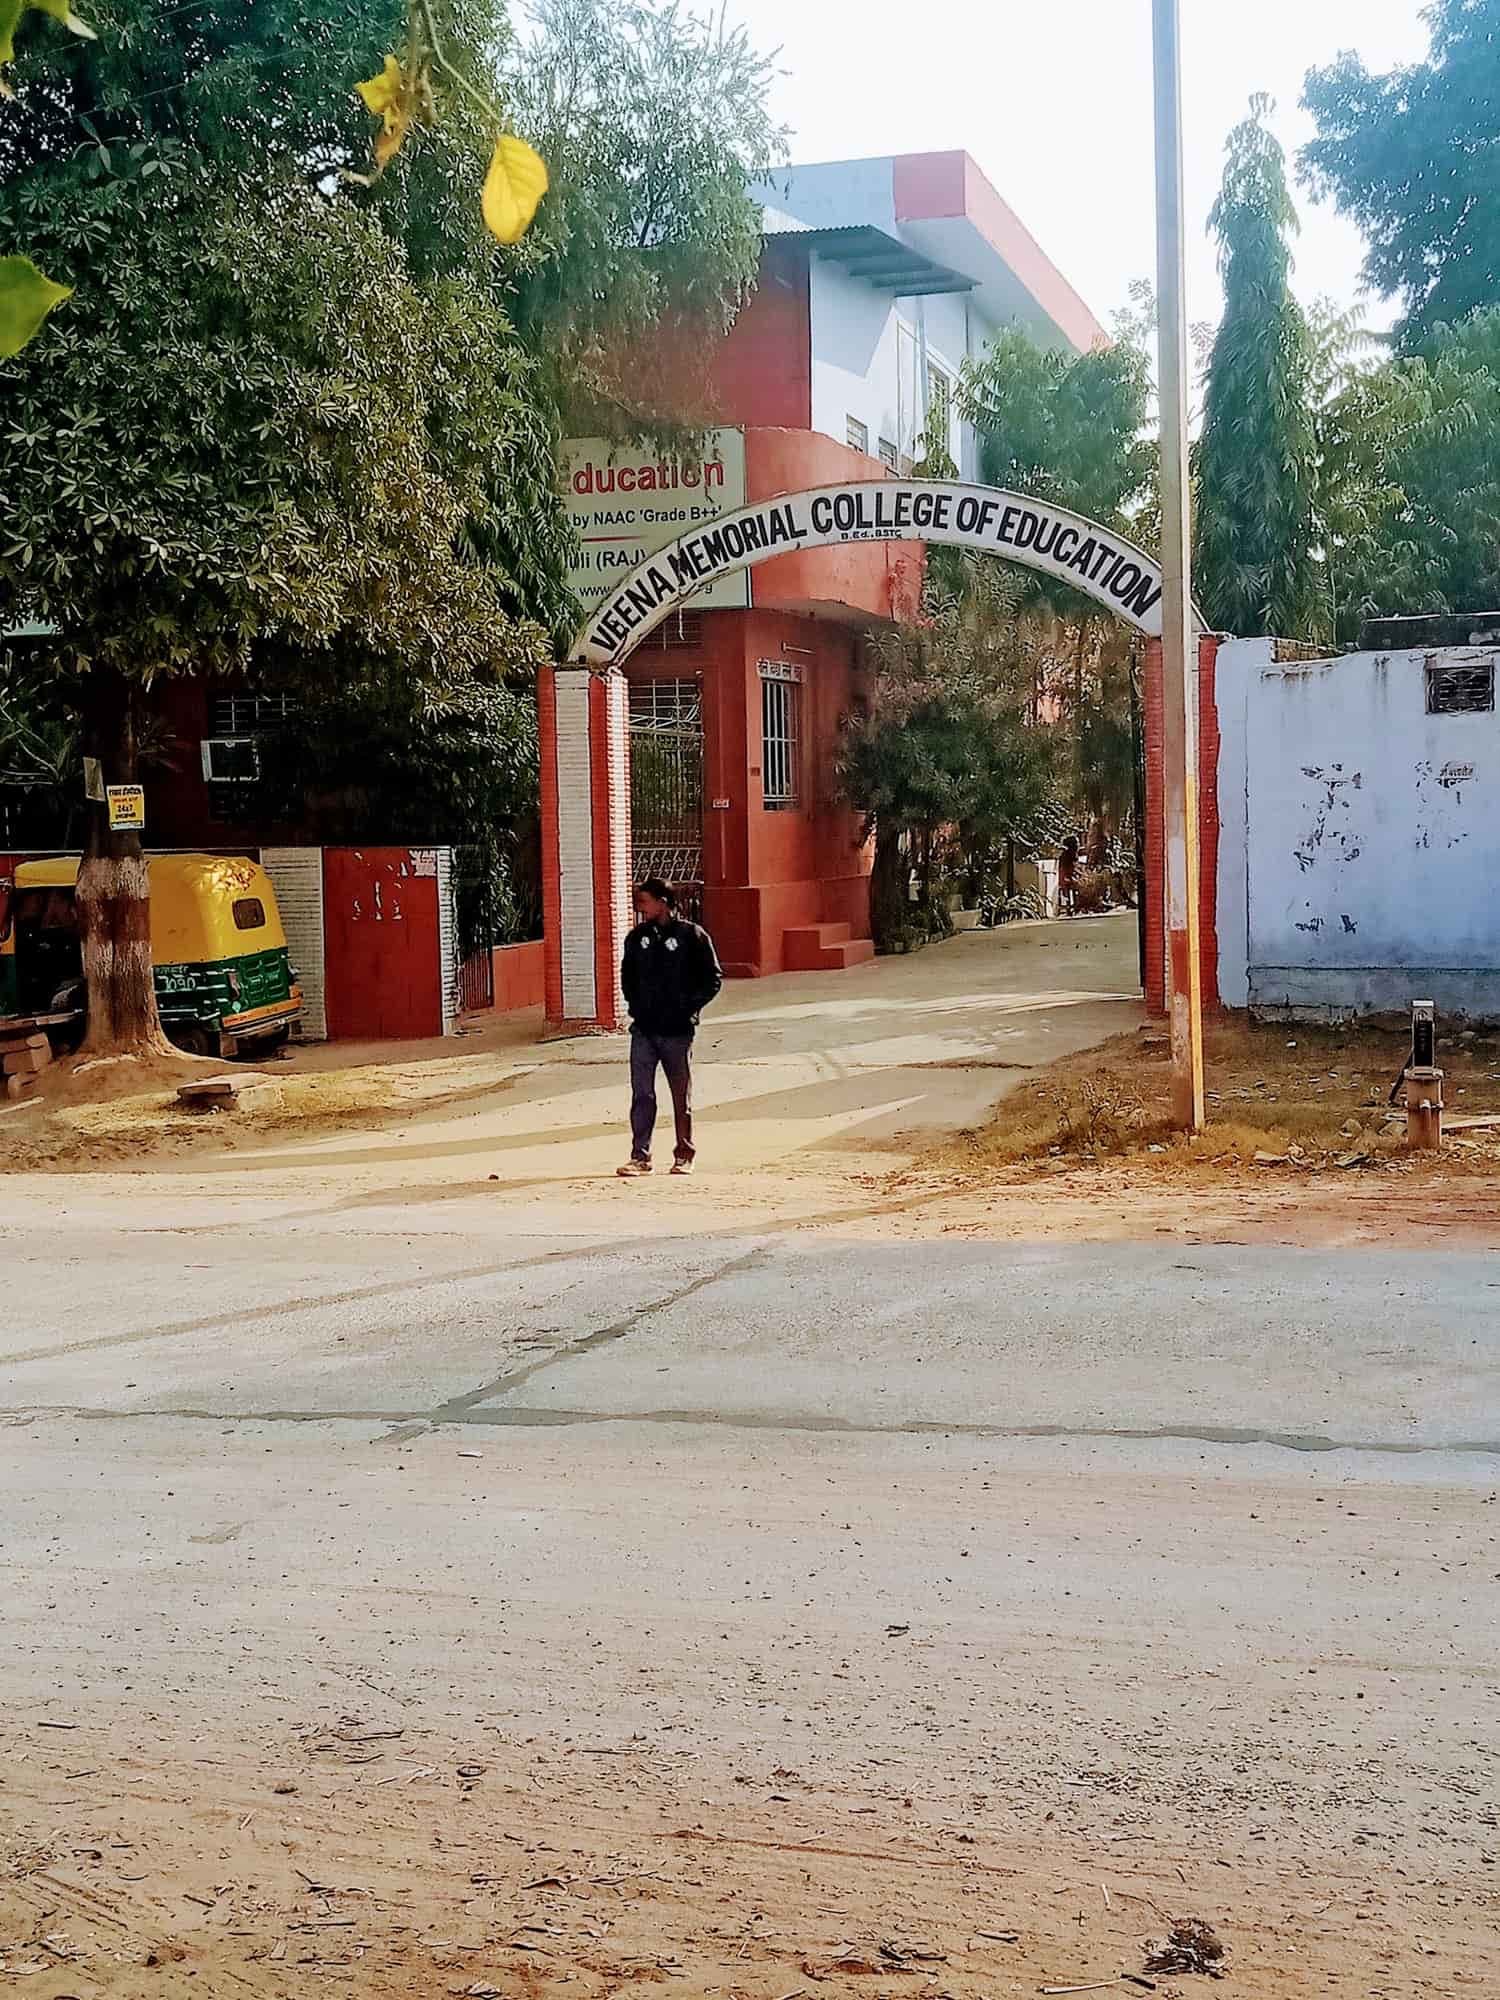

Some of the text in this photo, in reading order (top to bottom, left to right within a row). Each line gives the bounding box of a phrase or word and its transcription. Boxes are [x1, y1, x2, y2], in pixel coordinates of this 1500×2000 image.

[559, 461, 725, 495] ducation
[572, 513, 590, 529] by
[594, 510, 636, 526] NAAC
[640, 507, 687, 523] 'Grade
[590, 491, 1163, 653] VEENA MEMORIAL COLLEGE OF EDUCATION
